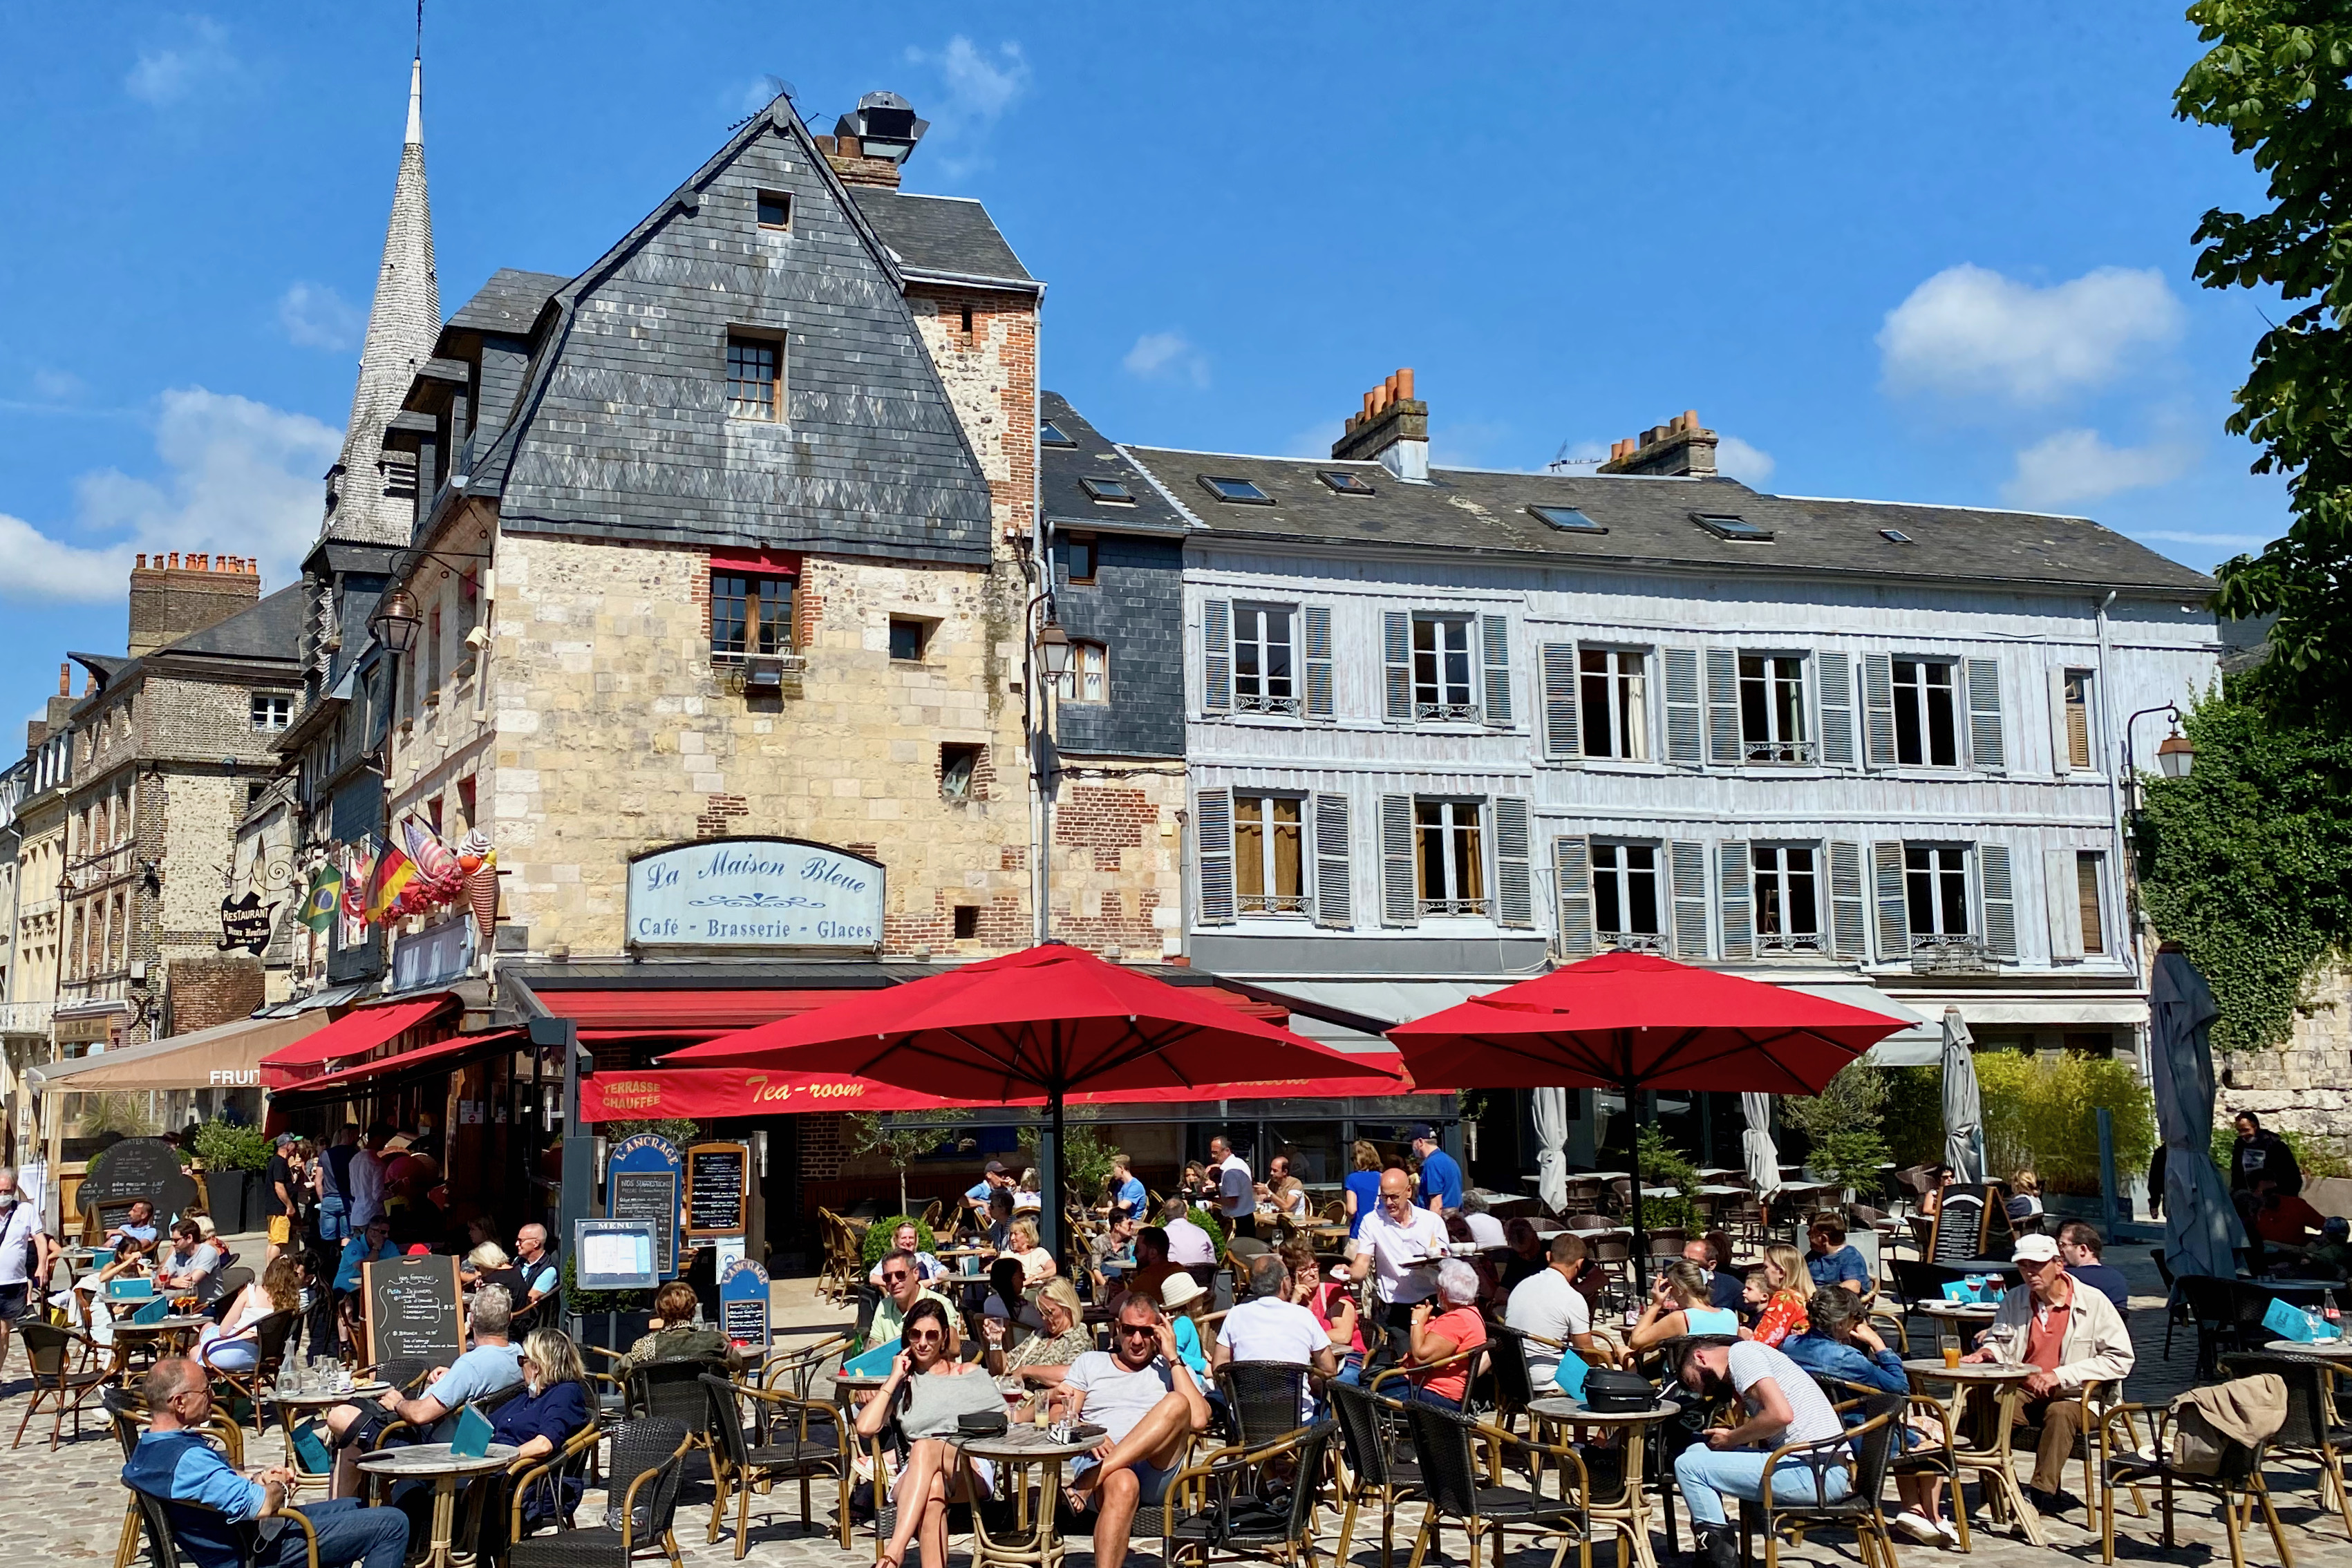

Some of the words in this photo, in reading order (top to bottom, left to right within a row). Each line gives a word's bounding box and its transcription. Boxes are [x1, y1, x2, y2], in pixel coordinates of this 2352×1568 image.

[647, 862, 679, 891] La
[697, 850, 784, 879] Maison
[801, 857, 866, 894] Bleue
[223, 907, 269, 922] RESTAURANT
[639, 917, 679, 936] Café
[707, 919, 790, 938] Brasserie
[818, 920, 872, 938] Glaces
[603, 1080, 660, 1094] TERRASSE
[745, 1075, 865, 1103] Tea-room
[602, 1093, 660, 1109] CHAUFFÉE
[614, 1136, 679, 1166] L'ANCRAGE
[722, 1260, 769, 1285] L'ANCRAGE
